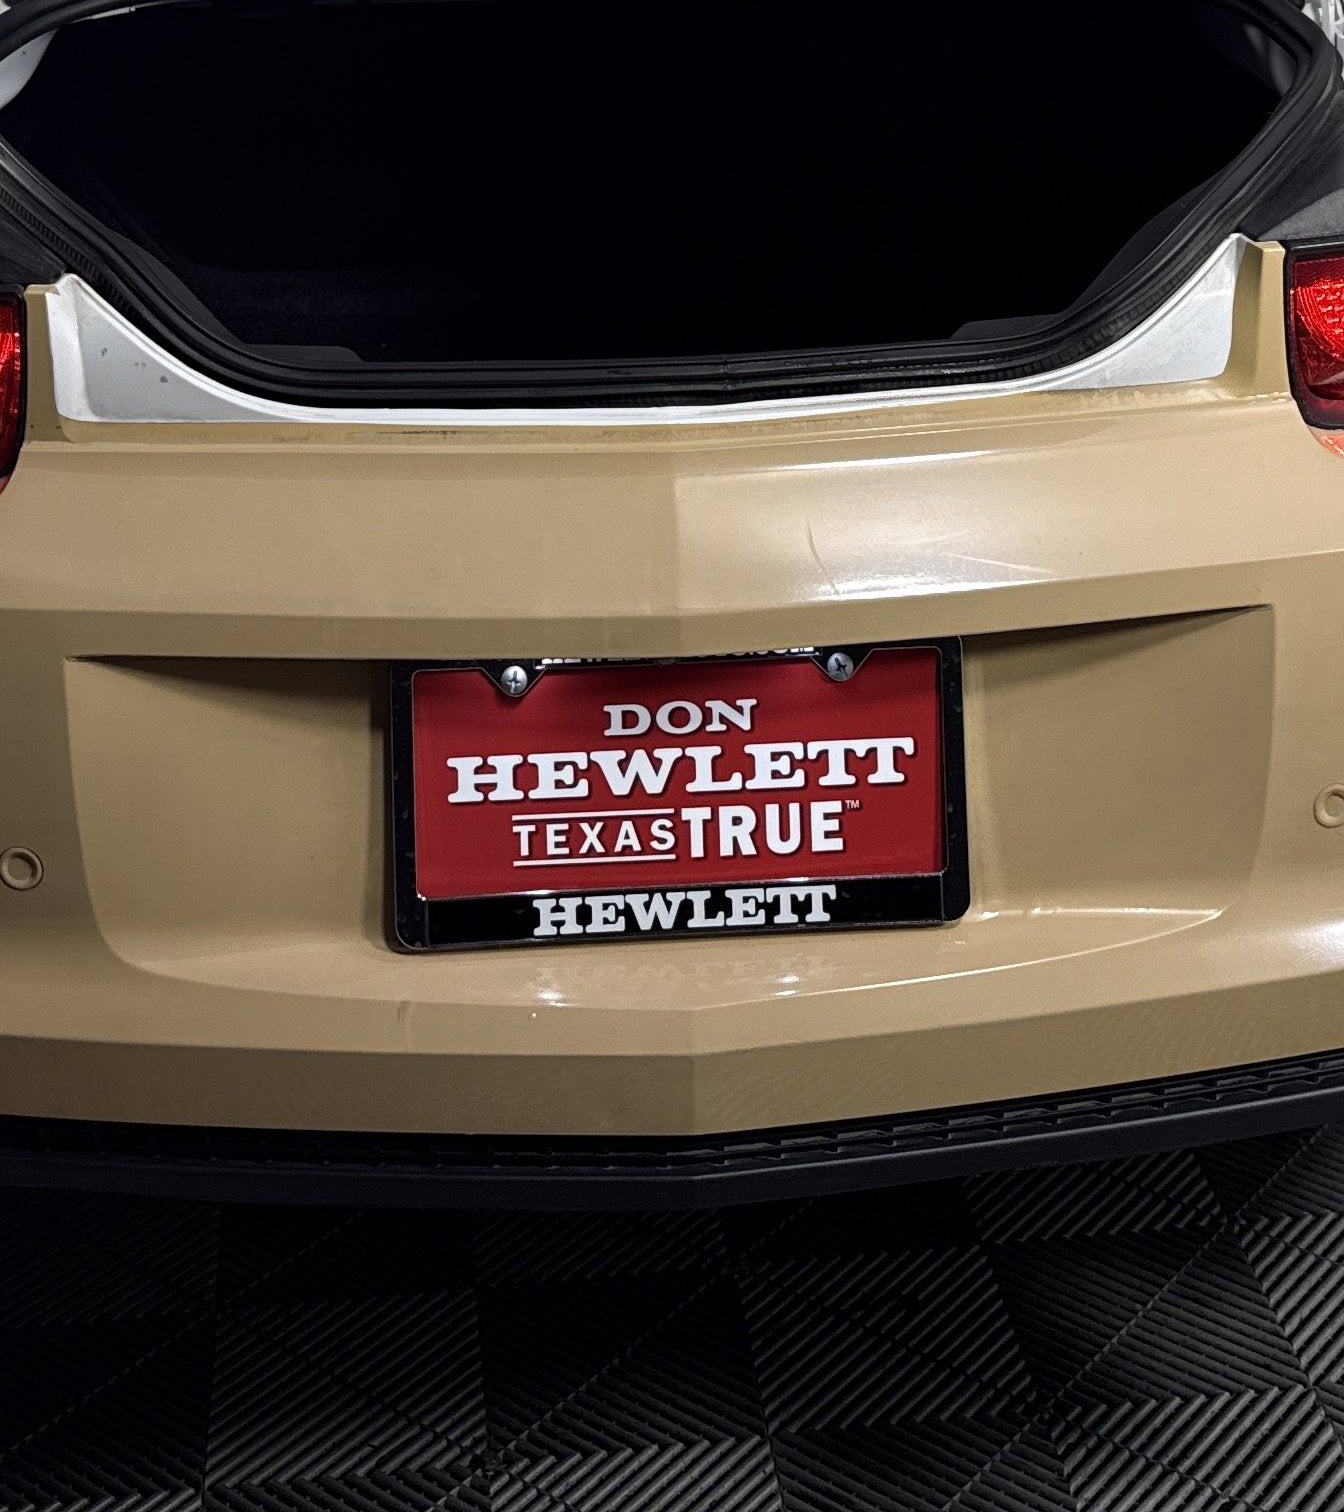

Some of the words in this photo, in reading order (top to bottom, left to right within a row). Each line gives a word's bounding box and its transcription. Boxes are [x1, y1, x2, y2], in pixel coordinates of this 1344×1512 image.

[603, 698, 758, 737] DON
[446, 736, 915, 803] HEWLETT
[532, 884, 837, 937] HEWLETT
